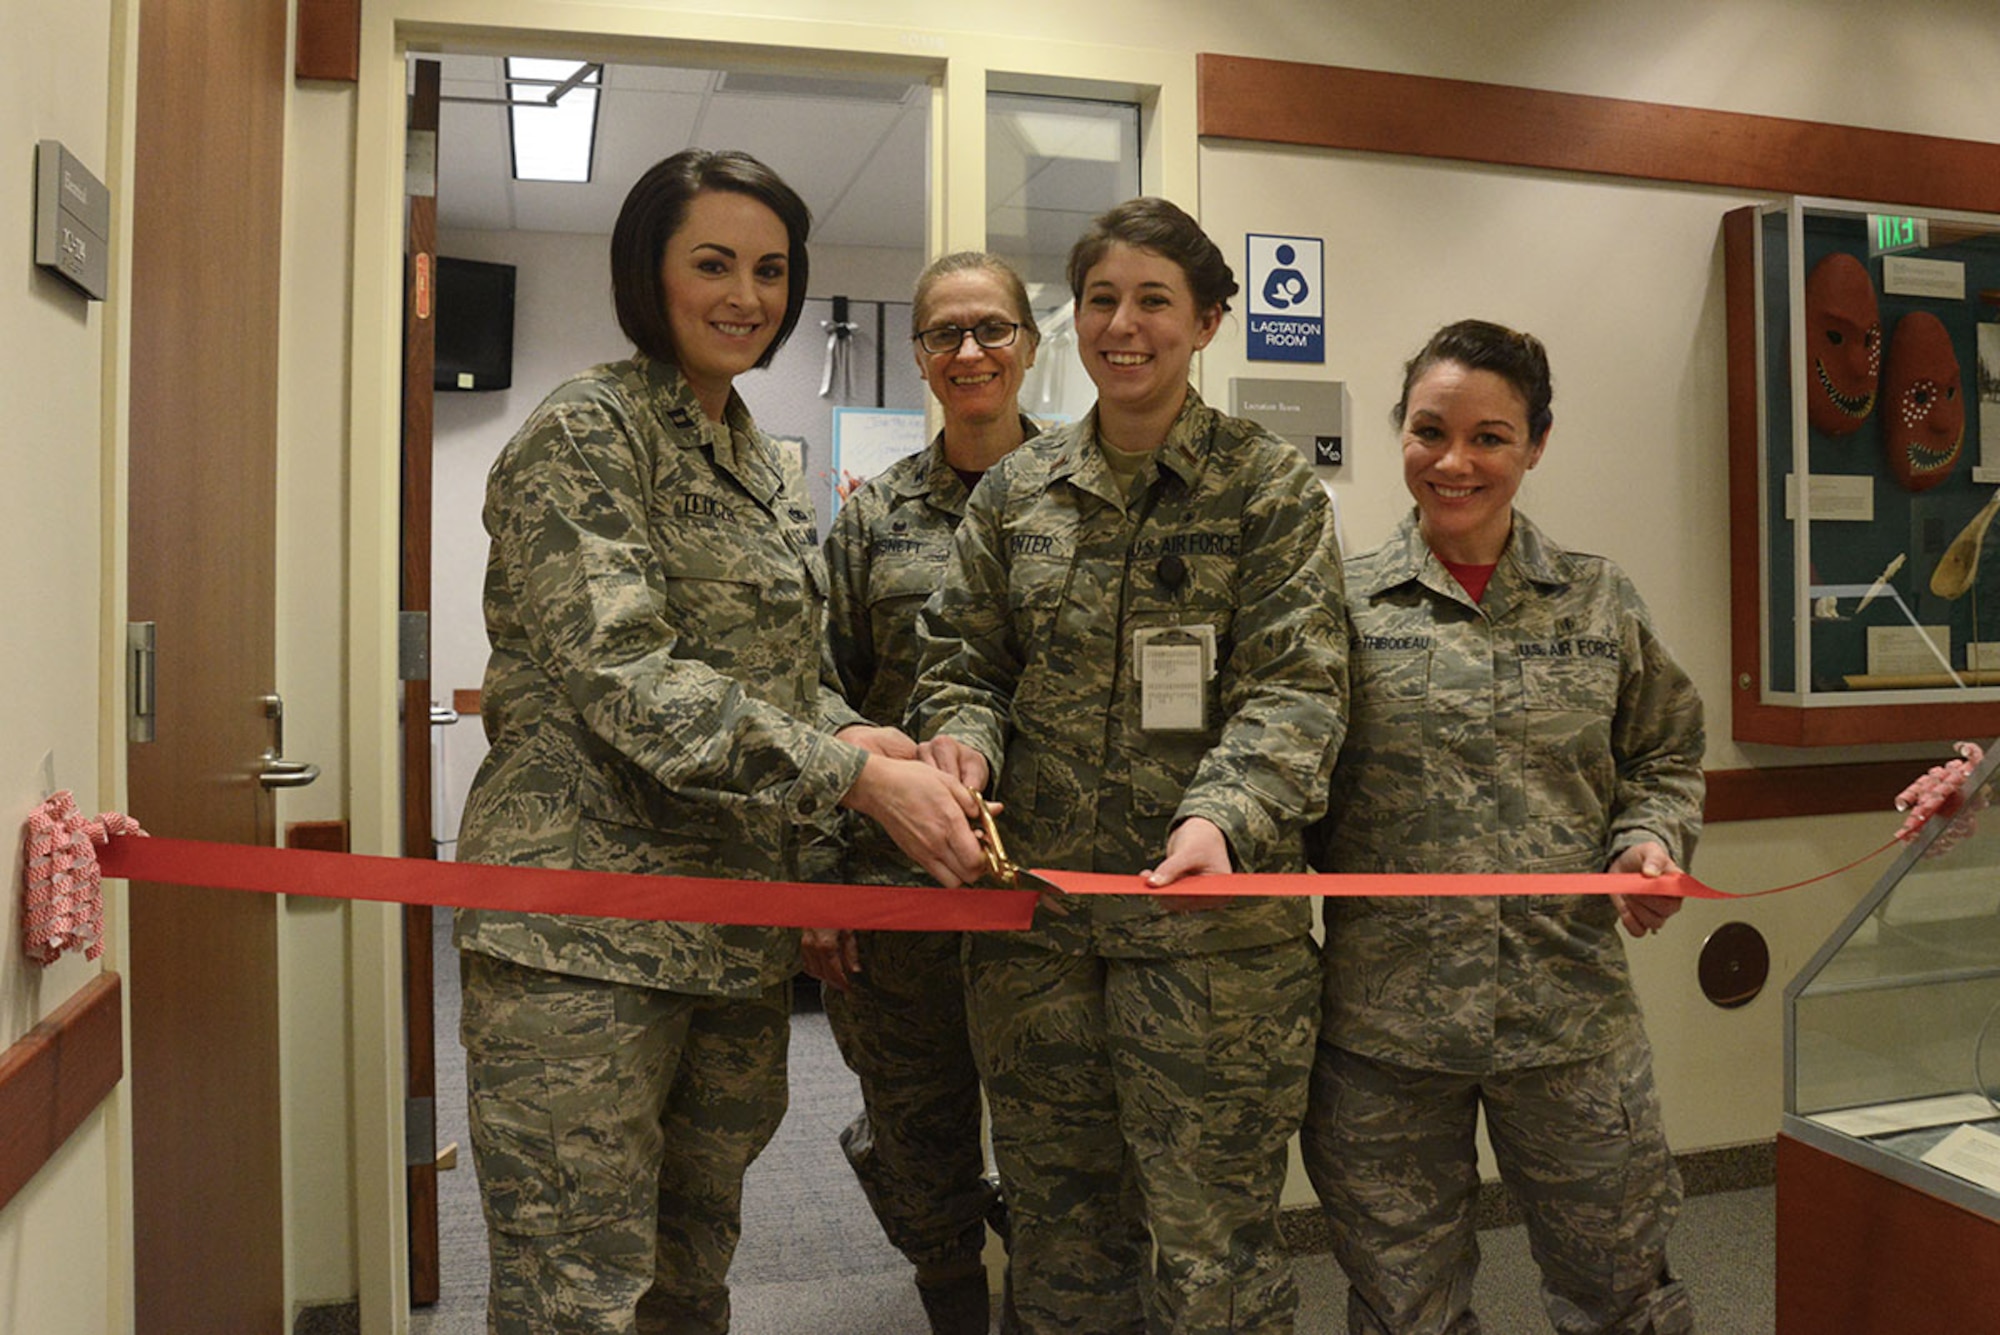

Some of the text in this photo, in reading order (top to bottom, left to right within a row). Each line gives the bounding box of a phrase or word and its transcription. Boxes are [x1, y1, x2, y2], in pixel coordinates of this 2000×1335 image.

[1250, 321, 1321, 335] LACTATION
[1265, 334, 1308, 347] ROOM
[1009, 534, 1053, 554] NTER
[1162, 534, 1187, 554] AIR
[1189, 532, 1241, 556] FORCE
[1363, 634, 1430, 650] THIBODEAU
[1549, 640, 1572, 657] AIR
[1577, 638, 1619, 661] FORCE
